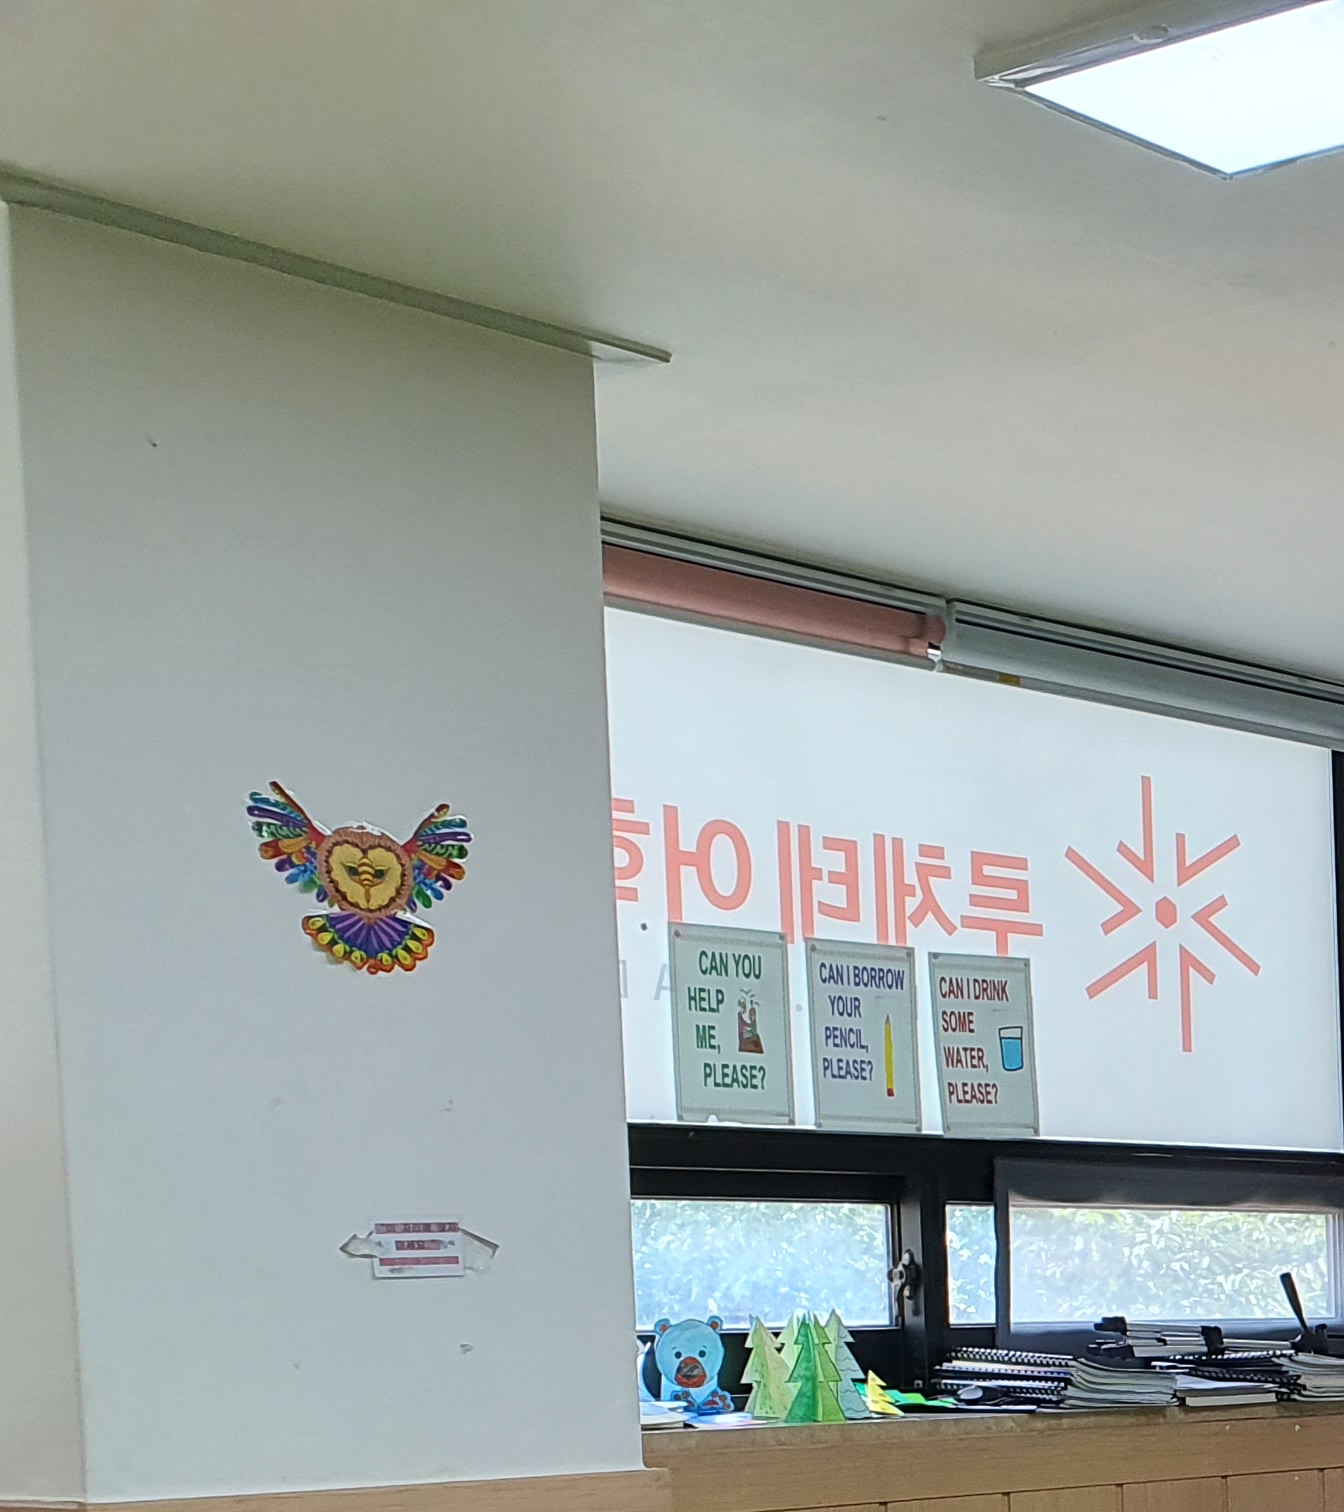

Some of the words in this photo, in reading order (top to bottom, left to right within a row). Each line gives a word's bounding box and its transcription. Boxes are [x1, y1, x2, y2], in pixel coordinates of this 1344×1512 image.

[698, 950, 729, 978] CAN
[732, 952, 762, 979] YOU
[819, 962, 844, 986] CAN
[853, 966, 905, 991] BORROW
[687, 986, 725, 1013] HELP
[939, 976, 964, 1000] CAN
[973, 978, 1009, 1002] DRINK
[828, 995, 862, 1018] YOUR
[941, 1010, 975, 1033] SOME
[695, 1024, 721, 1054] ME,
[825, 1026, 869, 1053] PENCIL,
[822, 1057, 873, 1081] PLEASE?
[943, 1046, 989, 1072] WATER,
[703, 1062, 766, 1090] PLEASE?
[947, 1082, 998, 1104] PLEASE?
